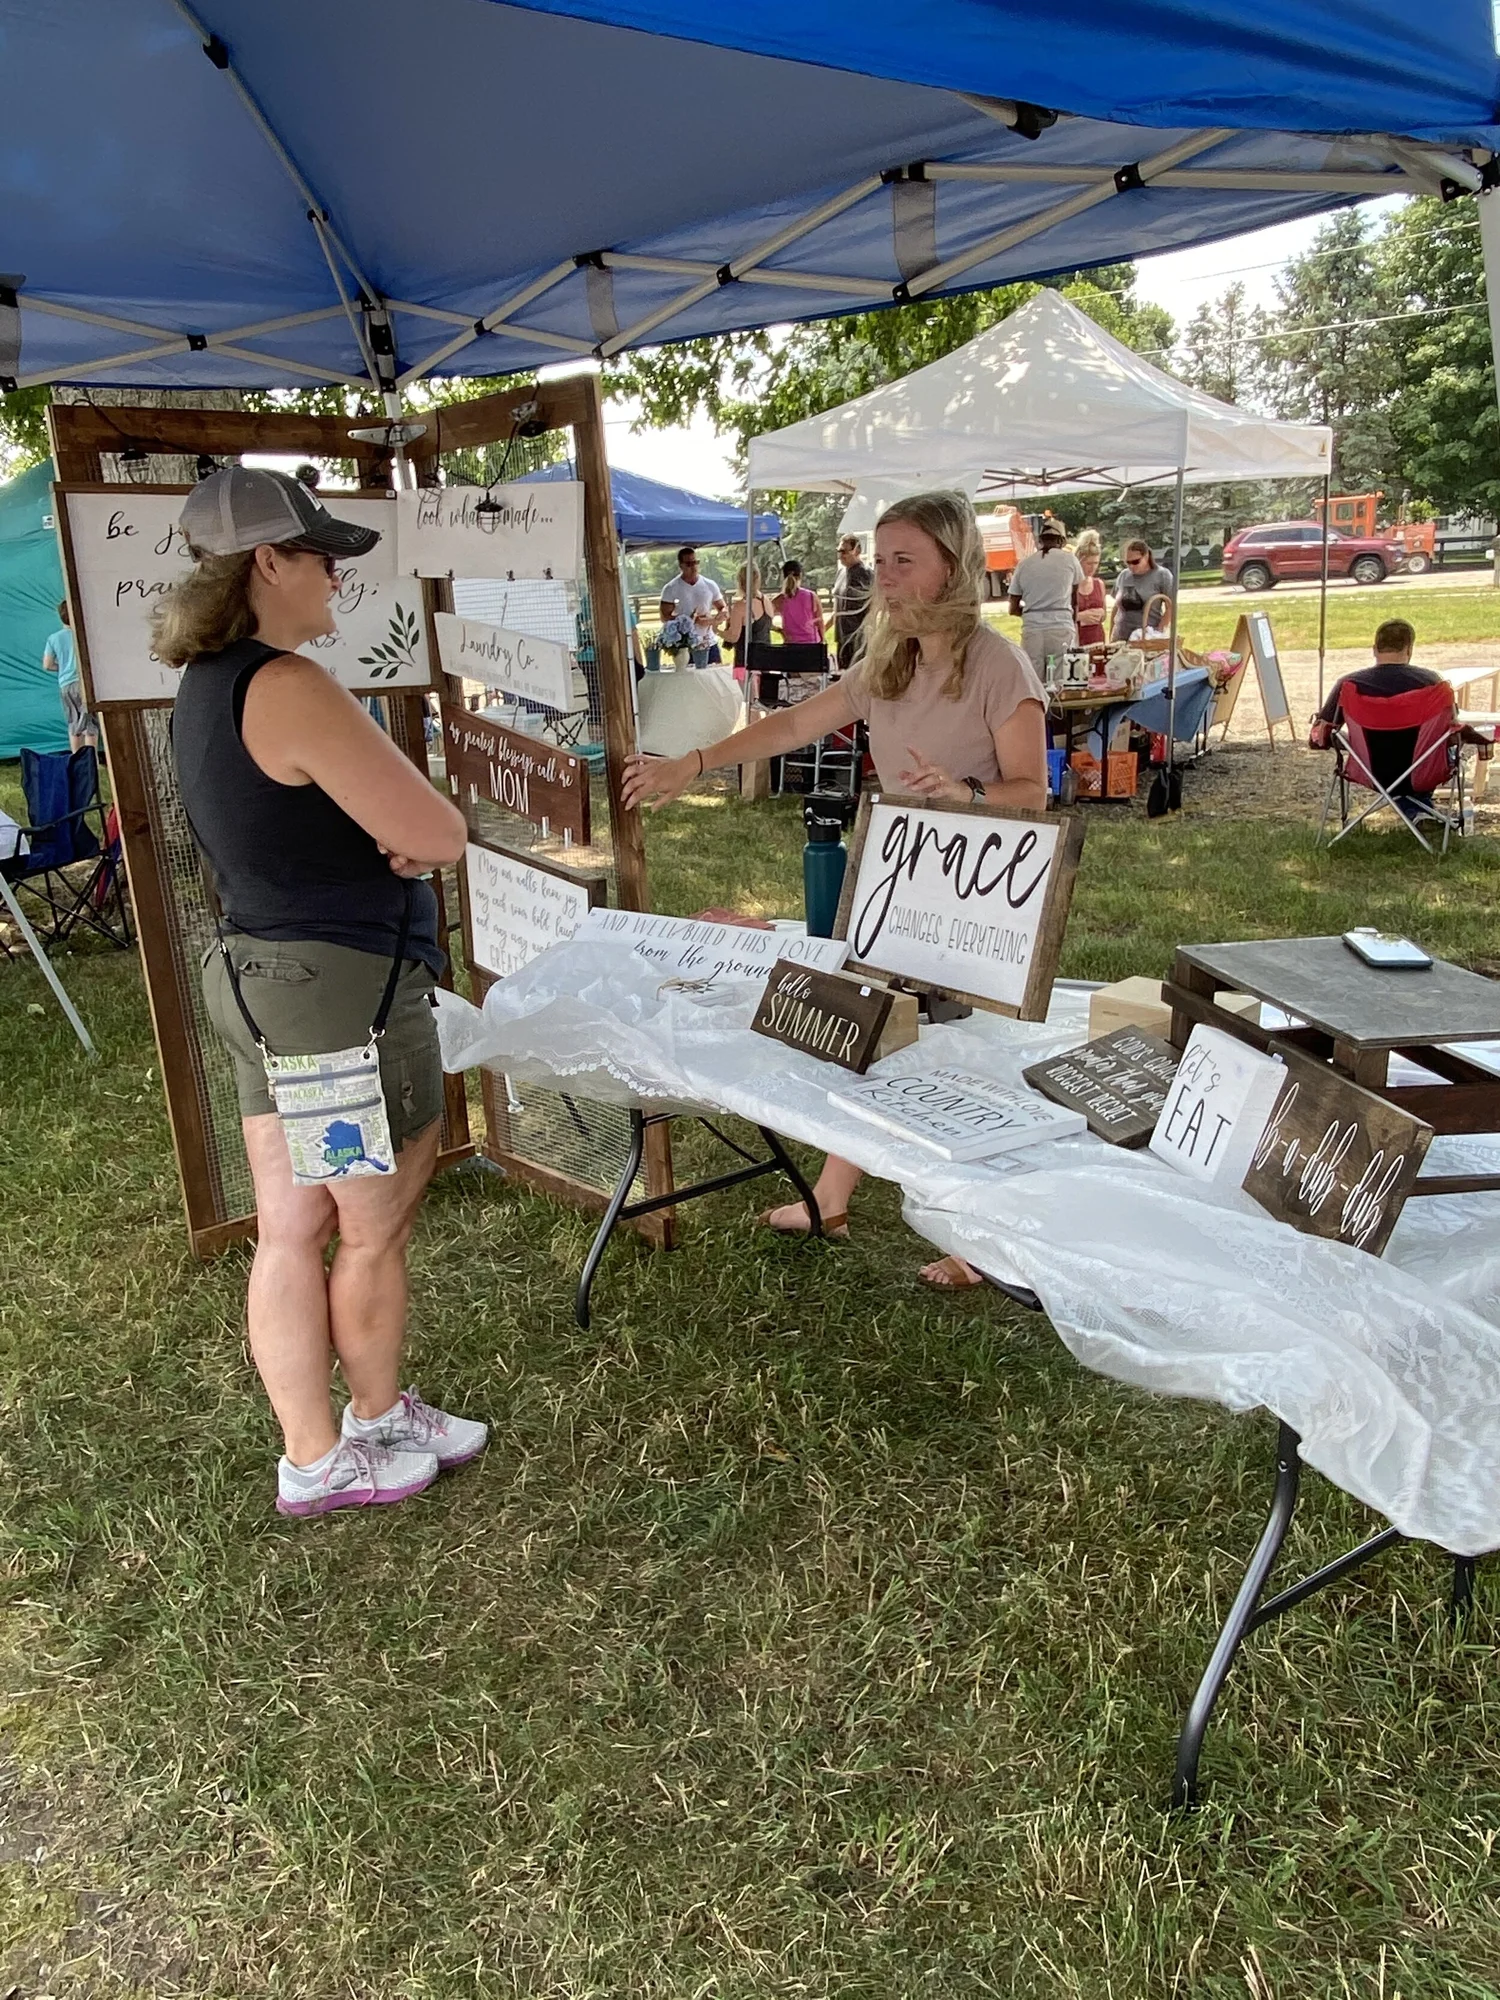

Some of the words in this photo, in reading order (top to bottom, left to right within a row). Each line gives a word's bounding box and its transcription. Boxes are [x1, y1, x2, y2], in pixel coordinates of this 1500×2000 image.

[105, 510, 140, 540] be
[416, 494, 443, 530] look
[460, 623, 513, 677] Laundry
[517, 638, 539, 671] Co.
[489, 761, 530, 815] MOM
[478, 851, 498, 887] May
[854, 813, 1052, 960] grace
[595, 912, 629, 932] AND
[681, 921, 727, 946] BUILD
[731, 930, 772, 954] THIS
[777, 938, 828, 963] LOVE
[633, 938, 671, 961] from
[677, 944, 709, 969] the
[888, 904, 943, 945] CHANGES
[948, 917, 1028, 966] EVERYTHING
[776, 971, 813, 999] hello
[761, 992, 860, 1062] SUMMER
[1111, 1035, 1154, 1062] GOD'S
[1060, 1048, 1118, 1073] greater
[1177, 1044, 1221, 1093] let's
[860, 1088, 961, 1137] Kitchen
[886, 1076, 1026, 1132] COUNTRY
[928, 1069, 984, 1087] MADE
[981, 1083, 1021, 1105] WITH
[1014, 1098, 1055, 1122] LOVE
[1045, 1062, 1101, 1098] BIGGEST
[1085, 1092, 1138, 1125] REGRET
[1164, 1083, 1232, 1167] EAT
